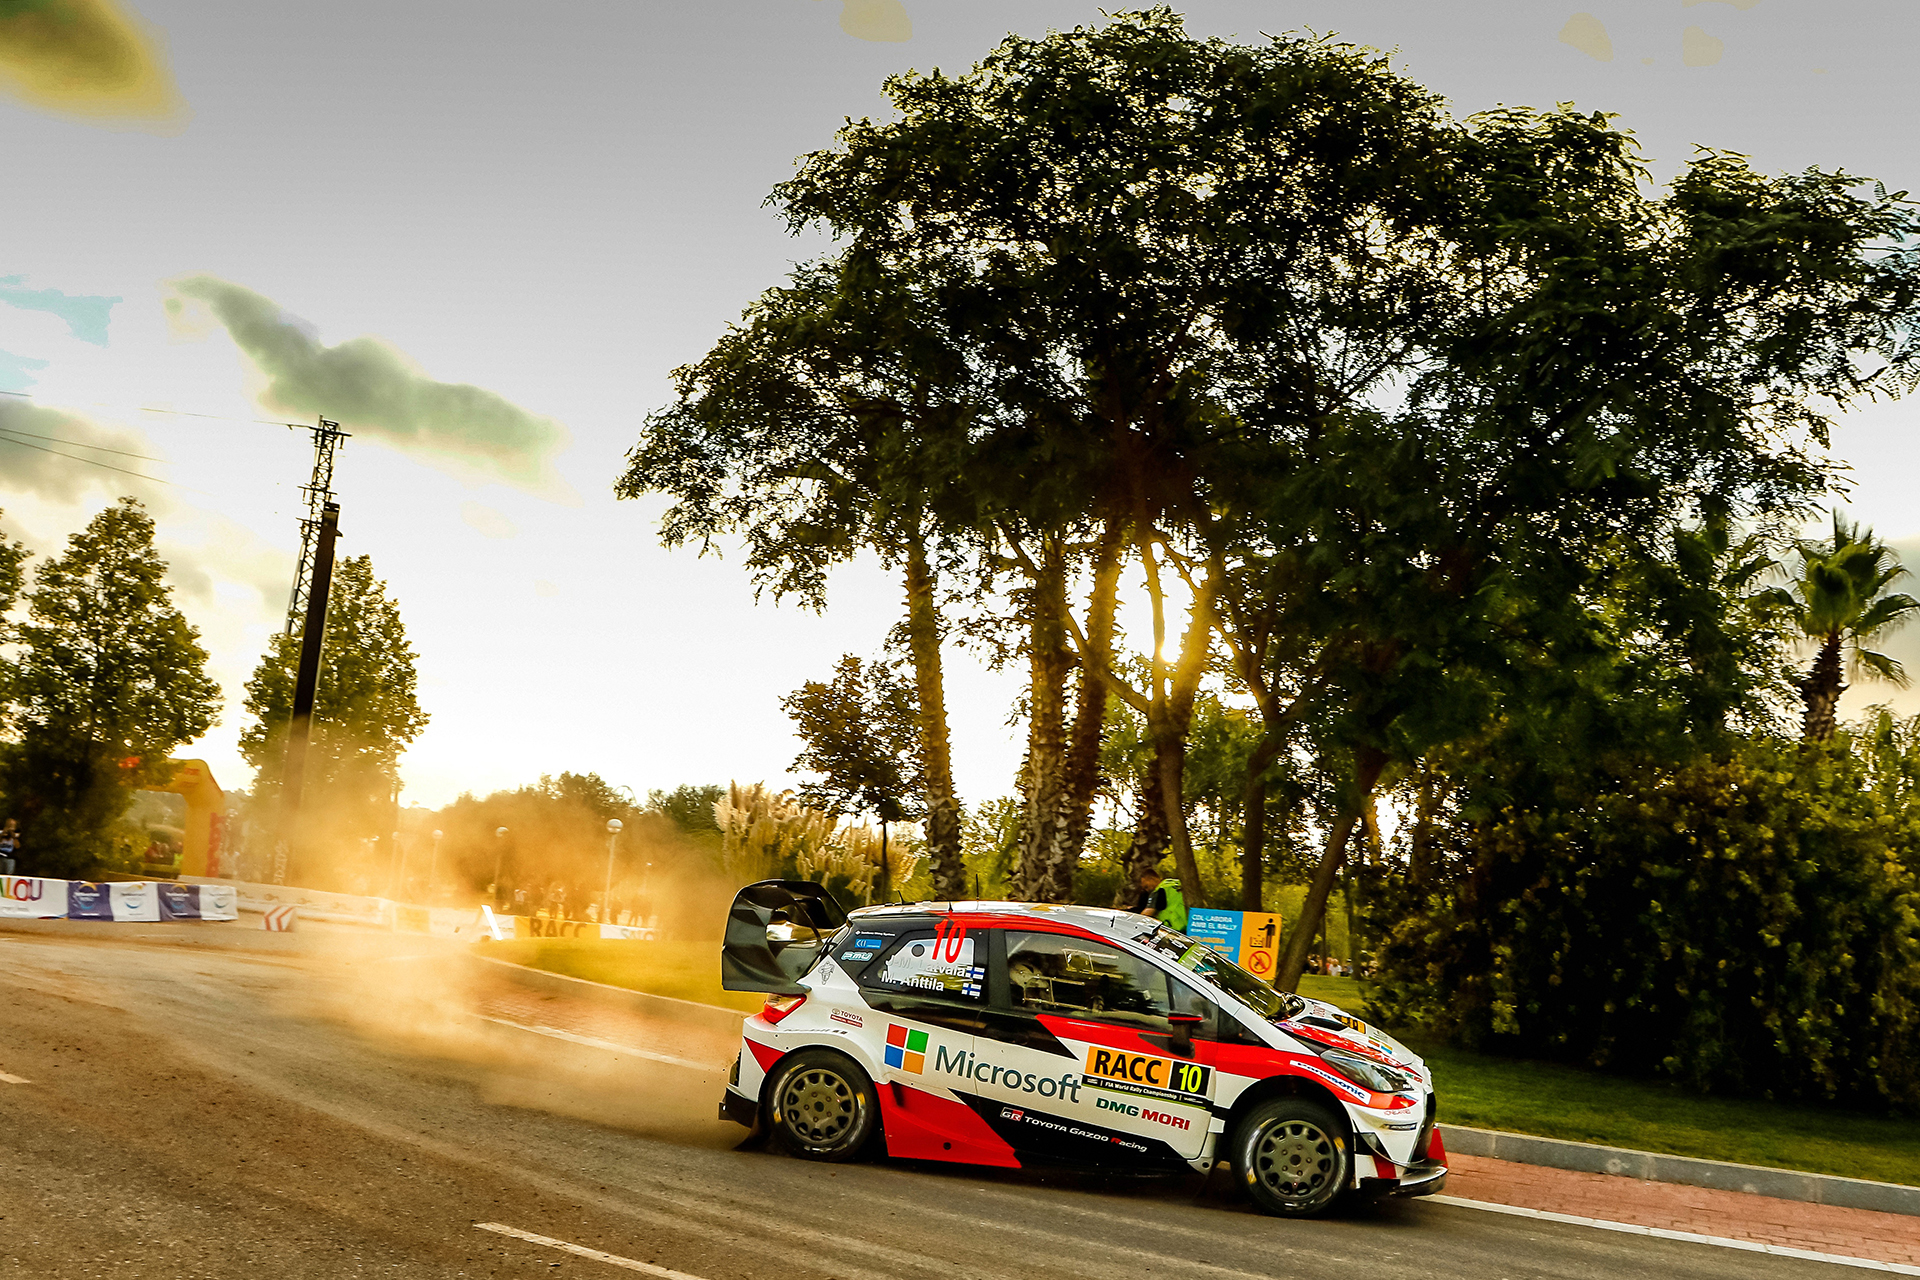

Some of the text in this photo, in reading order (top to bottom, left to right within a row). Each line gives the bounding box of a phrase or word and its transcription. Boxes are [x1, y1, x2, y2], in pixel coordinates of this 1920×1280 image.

[529, 917, 588, 938] RACC
[932, 918, 967, 964] 10
[900, 975, 945, 991] Anttila
[840, 1010, 863, 1022] TOYOTA
[935, 1045, 1081, 1104] Microsoft
[1094, 1049, 1202, 1093] RACC 10
[1297, 1062, 1365, 1099] Panasonic
[1114, 1083, 1129, 1091] World
[1129, 1086, 1142, 1094] Rally
[1143, 1088, 1177, 1100] Championship
[1001, 1110, 1023, 1122] GR
[1025, 1116, 1067, 1132] TOYOTA
[1110, 1137, 1148, 1153] Racing
[1095, 1097, 1191, 1131] DMG MORI
